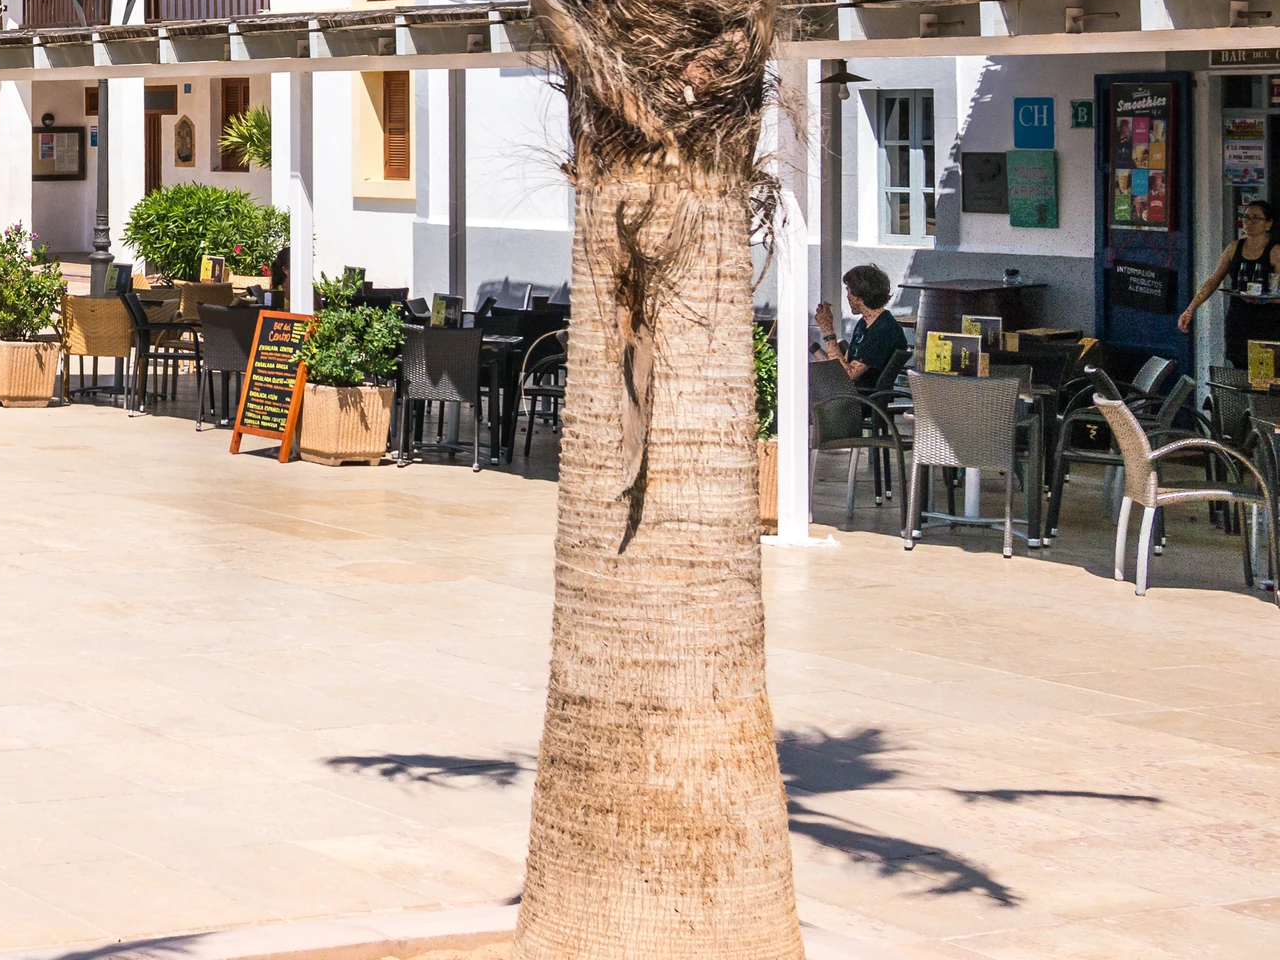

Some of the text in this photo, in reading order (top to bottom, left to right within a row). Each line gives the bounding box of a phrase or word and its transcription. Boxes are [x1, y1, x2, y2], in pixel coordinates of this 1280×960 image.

[1221, 50, 1246, 62] BAR
[1252, 51, 1270, 59] DEL
[1117, 96, 1167, 112] Smoothies
[1018, 105, 1048, 127] CH
[1077, 107, 1088, 122] B
